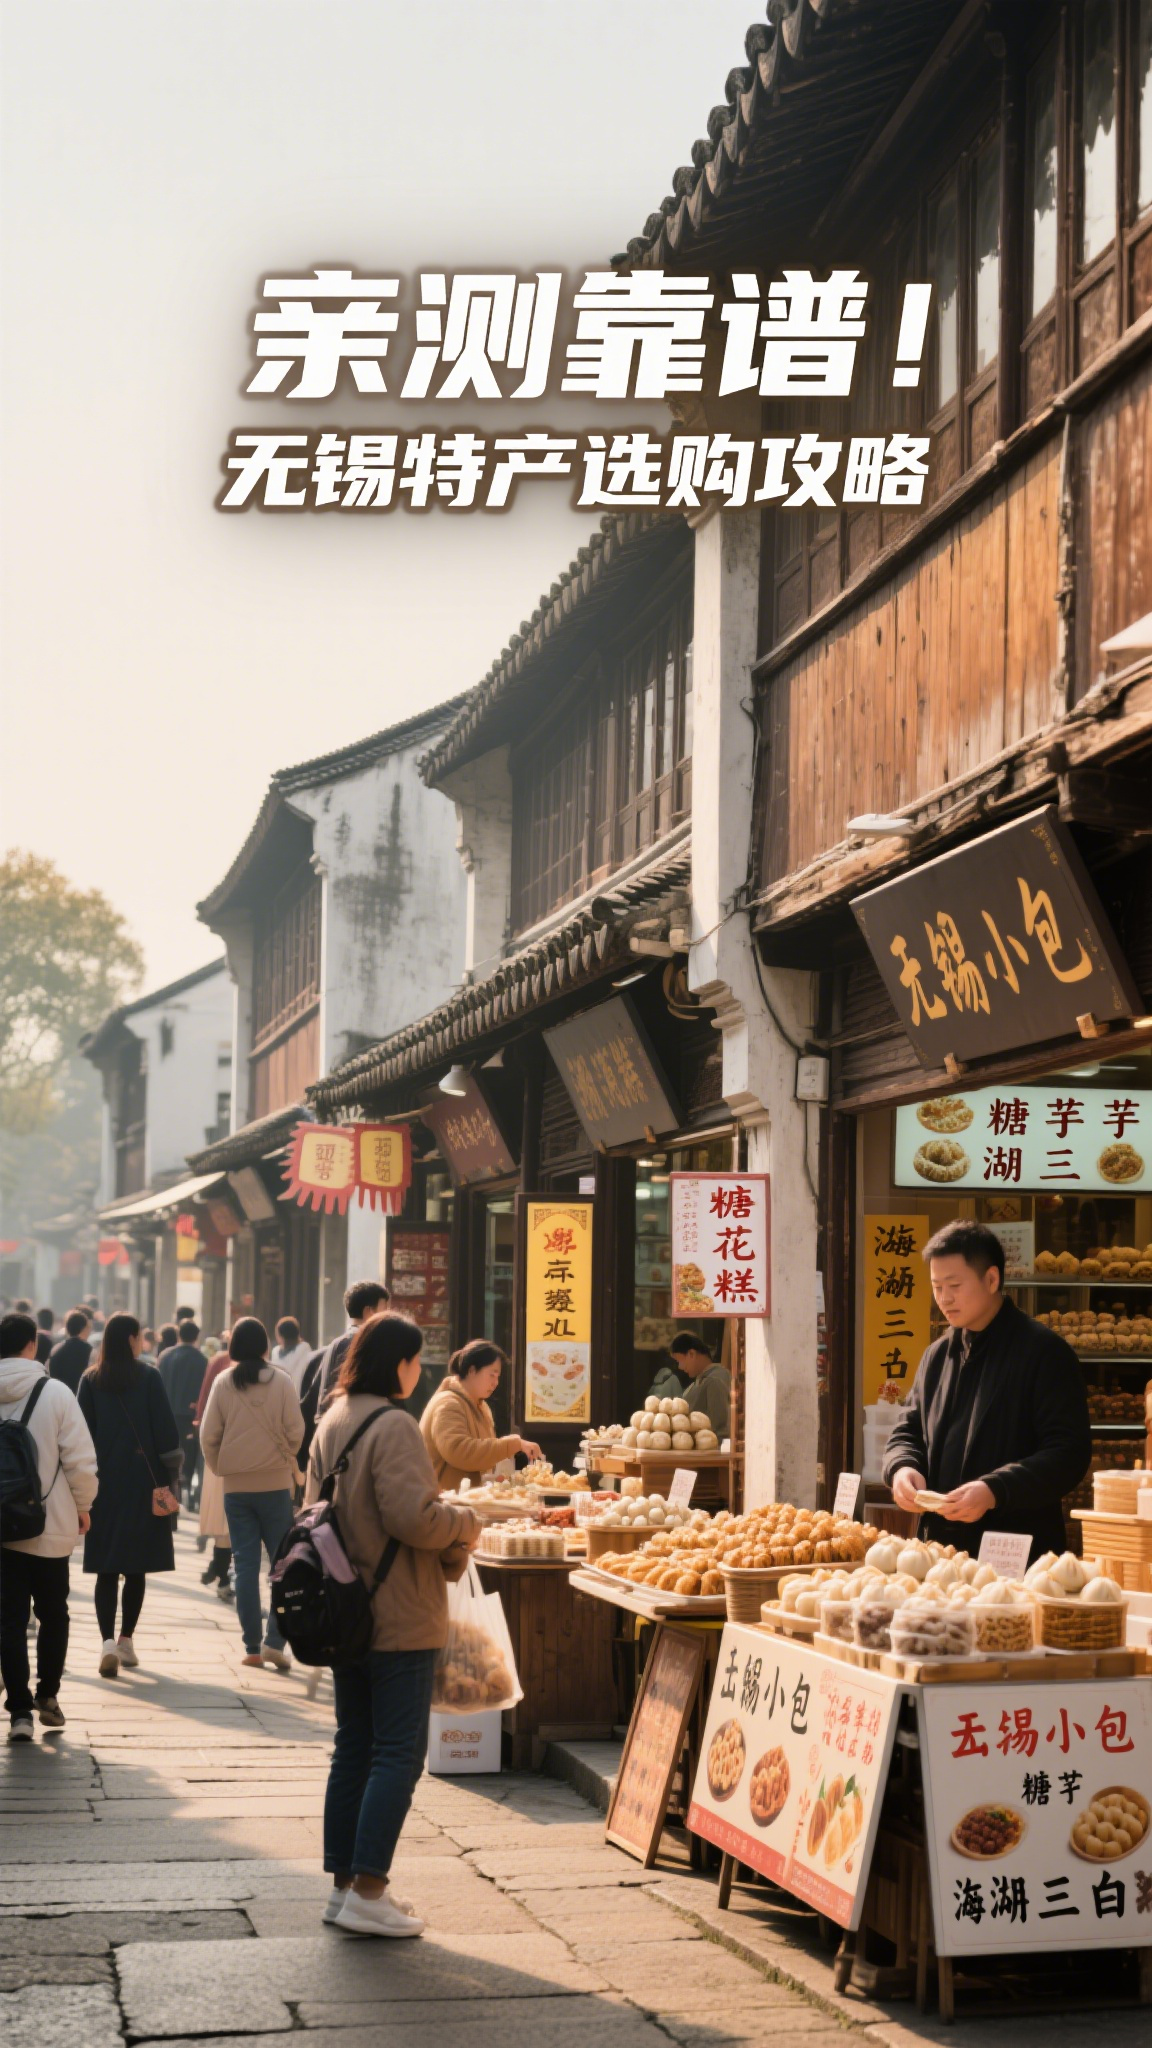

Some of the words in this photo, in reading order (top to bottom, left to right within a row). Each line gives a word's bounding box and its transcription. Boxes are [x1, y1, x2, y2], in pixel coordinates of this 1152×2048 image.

[890, 877, 1093, 1026] 无锡小包
[986, 1097, 1140, 1139] 糖芋芋
[983, 1146, 1081, 1182] 湖三
[709, 1185, 759, 1304] 糖花糕
[1021, 1770, 1083, 1805] 糖芋
